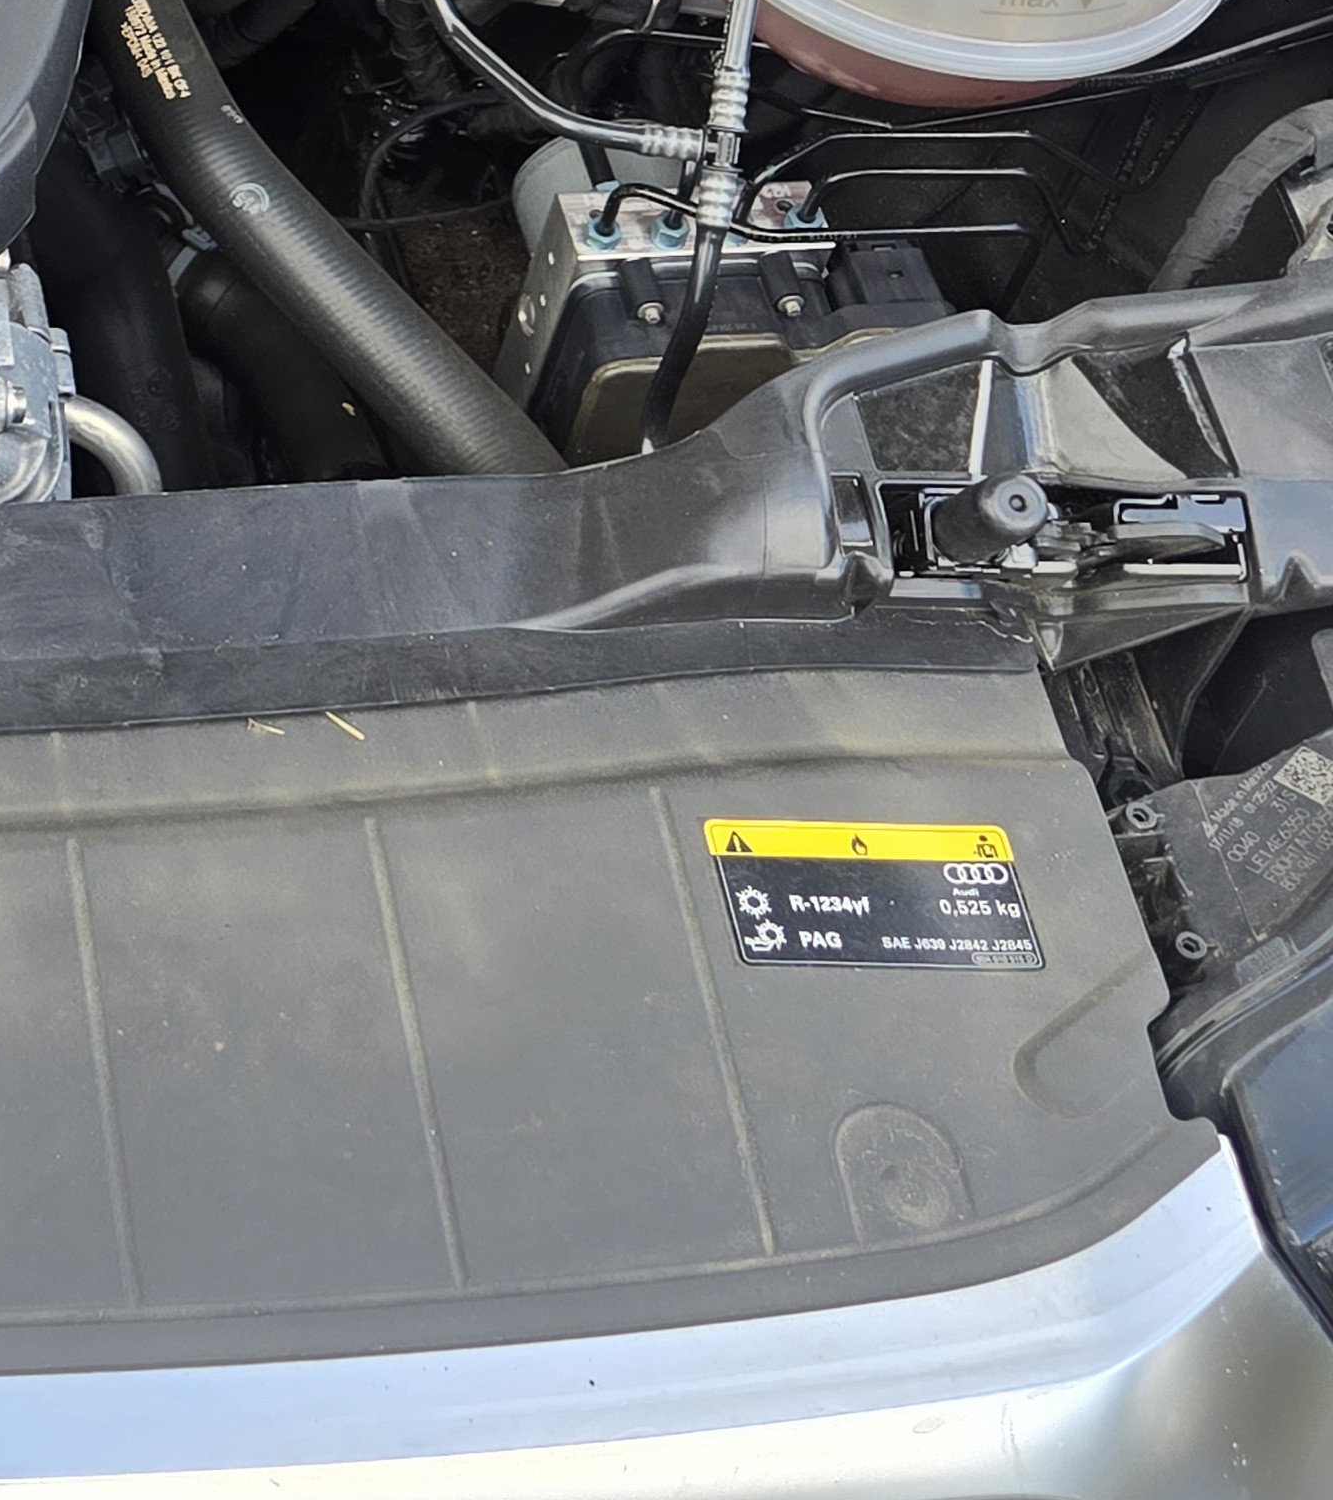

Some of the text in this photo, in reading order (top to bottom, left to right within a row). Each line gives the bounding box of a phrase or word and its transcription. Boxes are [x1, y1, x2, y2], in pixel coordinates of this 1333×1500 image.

[952, 887, 979, 897] Audi
[788, 894, 1022, 918] R-1234yf 0,525 kg
[798, 930, 842, 949] PAG
[881, 936, 912, 949] SAE
[914, 937, 946, 950] J639
[949, 938, 989, 951] J2842
